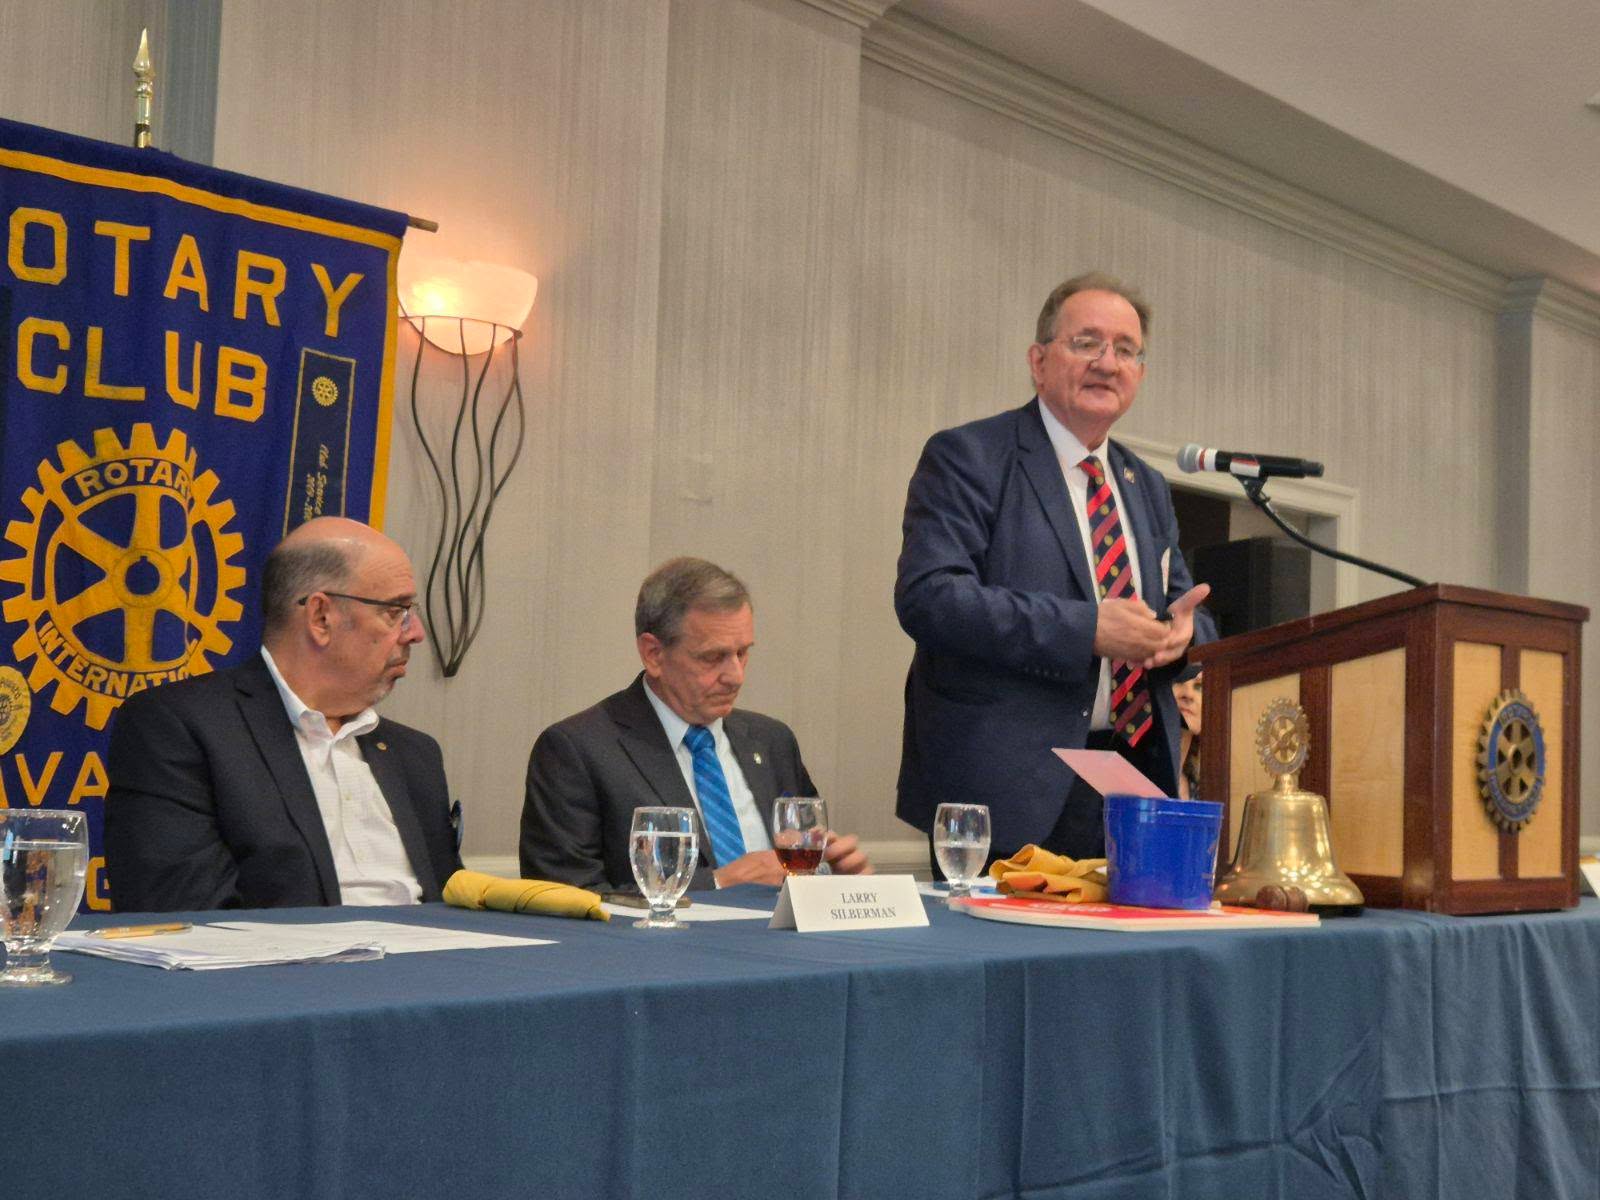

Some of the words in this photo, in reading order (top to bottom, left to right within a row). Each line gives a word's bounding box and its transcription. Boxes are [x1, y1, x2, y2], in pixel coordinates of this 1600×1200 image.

[8, 206, 364, 338] OTARY
[16, 316, 269, 423] CLUB
[74, 459, 192, 498] ROTAR
[830, 907, 896, 920] SILBERMAN
[841, 892, 877, 904] LARRY
